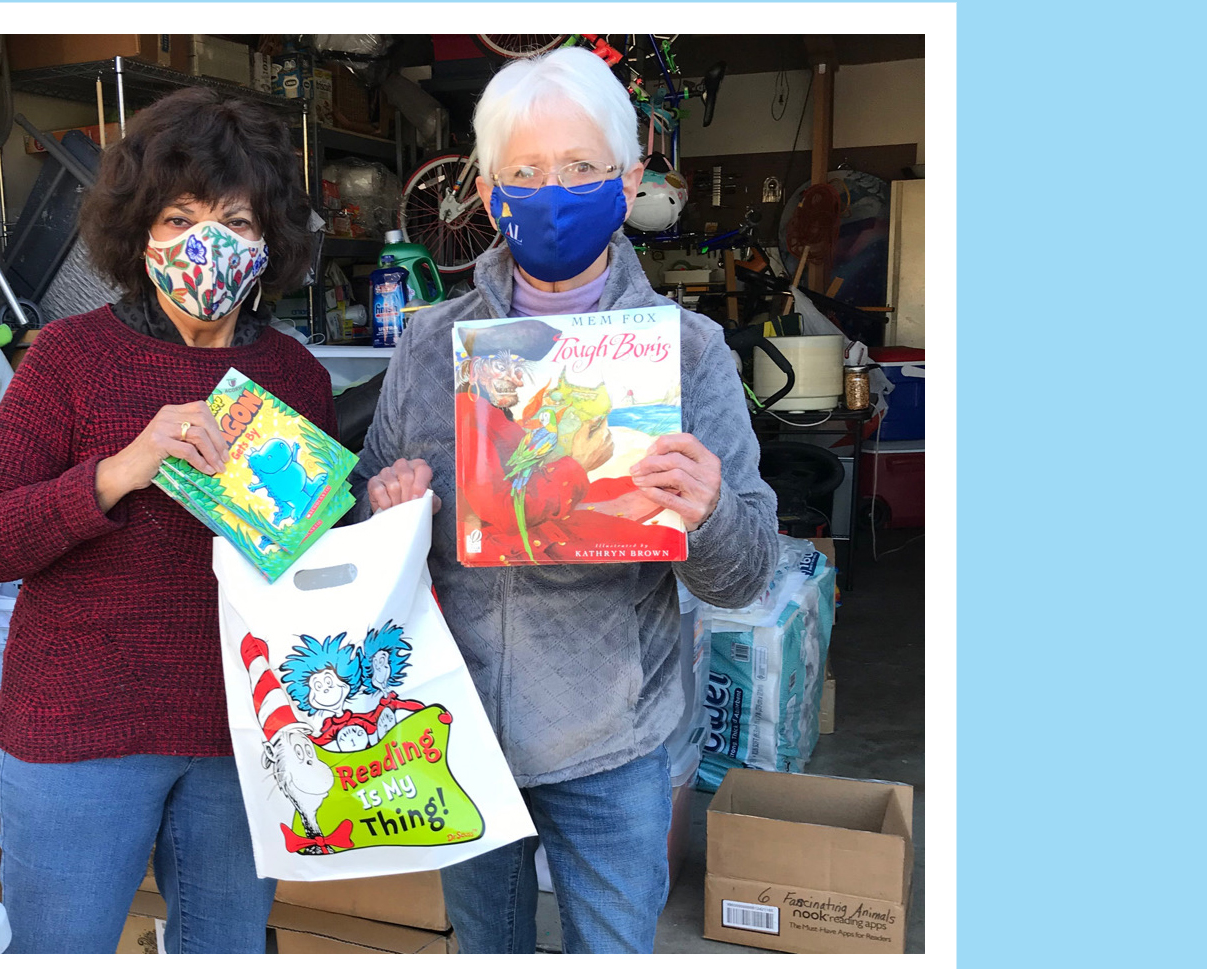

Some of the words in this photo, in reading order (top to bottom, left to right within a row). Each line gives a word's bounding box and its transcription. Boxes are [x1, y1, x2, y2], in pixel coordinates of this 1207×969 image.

[571, 315, 612, 327] MEM
[622, 312, 657, 325] FOX
[551, 332, 609, 373] Tough
[609, 332, 672, 363] Boris
[220, 389, 264, 450] AGON
[230, 441, 248, 461] Gets
[245, 427, 262, 442] By
[630, 549, 670, 557] BROWN
[339, 727, 364, 743] THING
[335, 728, 442, 791] Reading
[357, 786, 383, 810] Is
[382, 774, 418, 802] My
[360, 787, 449, 837] Thing!
[757, 887, 771, 903] 6
[782, 891, 847, 918] Fascinating
[851, 902, 896, 924] Animals
[829, 915, 864, 929] reading
[865, 920, 887, 931] apps
[789, 922, 801, 930] The
[838, 929, 855, 938] Apps
[866, 933, 892, 943] Readers
